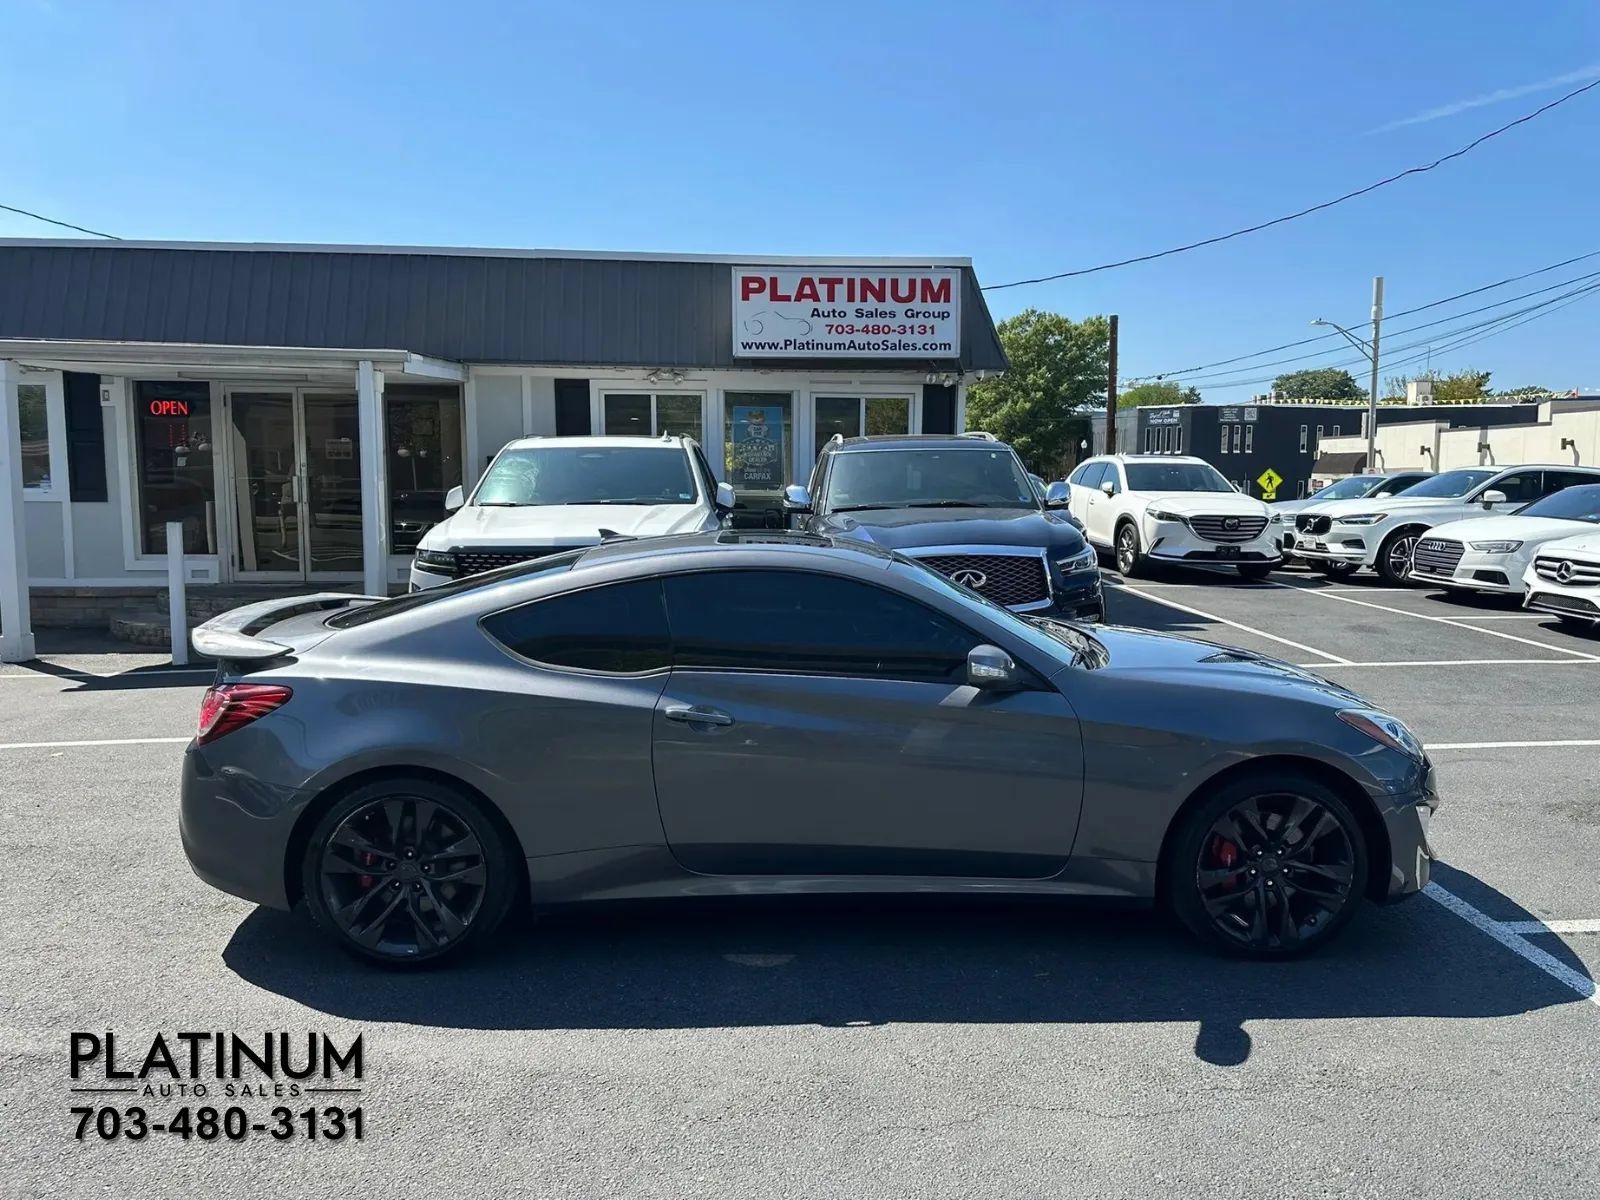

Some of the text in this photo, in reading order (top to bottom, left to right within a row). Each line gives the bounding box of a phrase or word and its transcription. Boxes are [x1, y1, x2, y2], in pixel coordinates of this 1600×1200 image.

[741, 276, 951, 303] PLATINUM
[810, 308, 951, 320] Auto Sales Group
[825, 324, 936, 336] 703-480-3131
[741, 339, 952, 351] www.PlatinumAutoSales.com
[150, 400, 188, 415] OPEN
